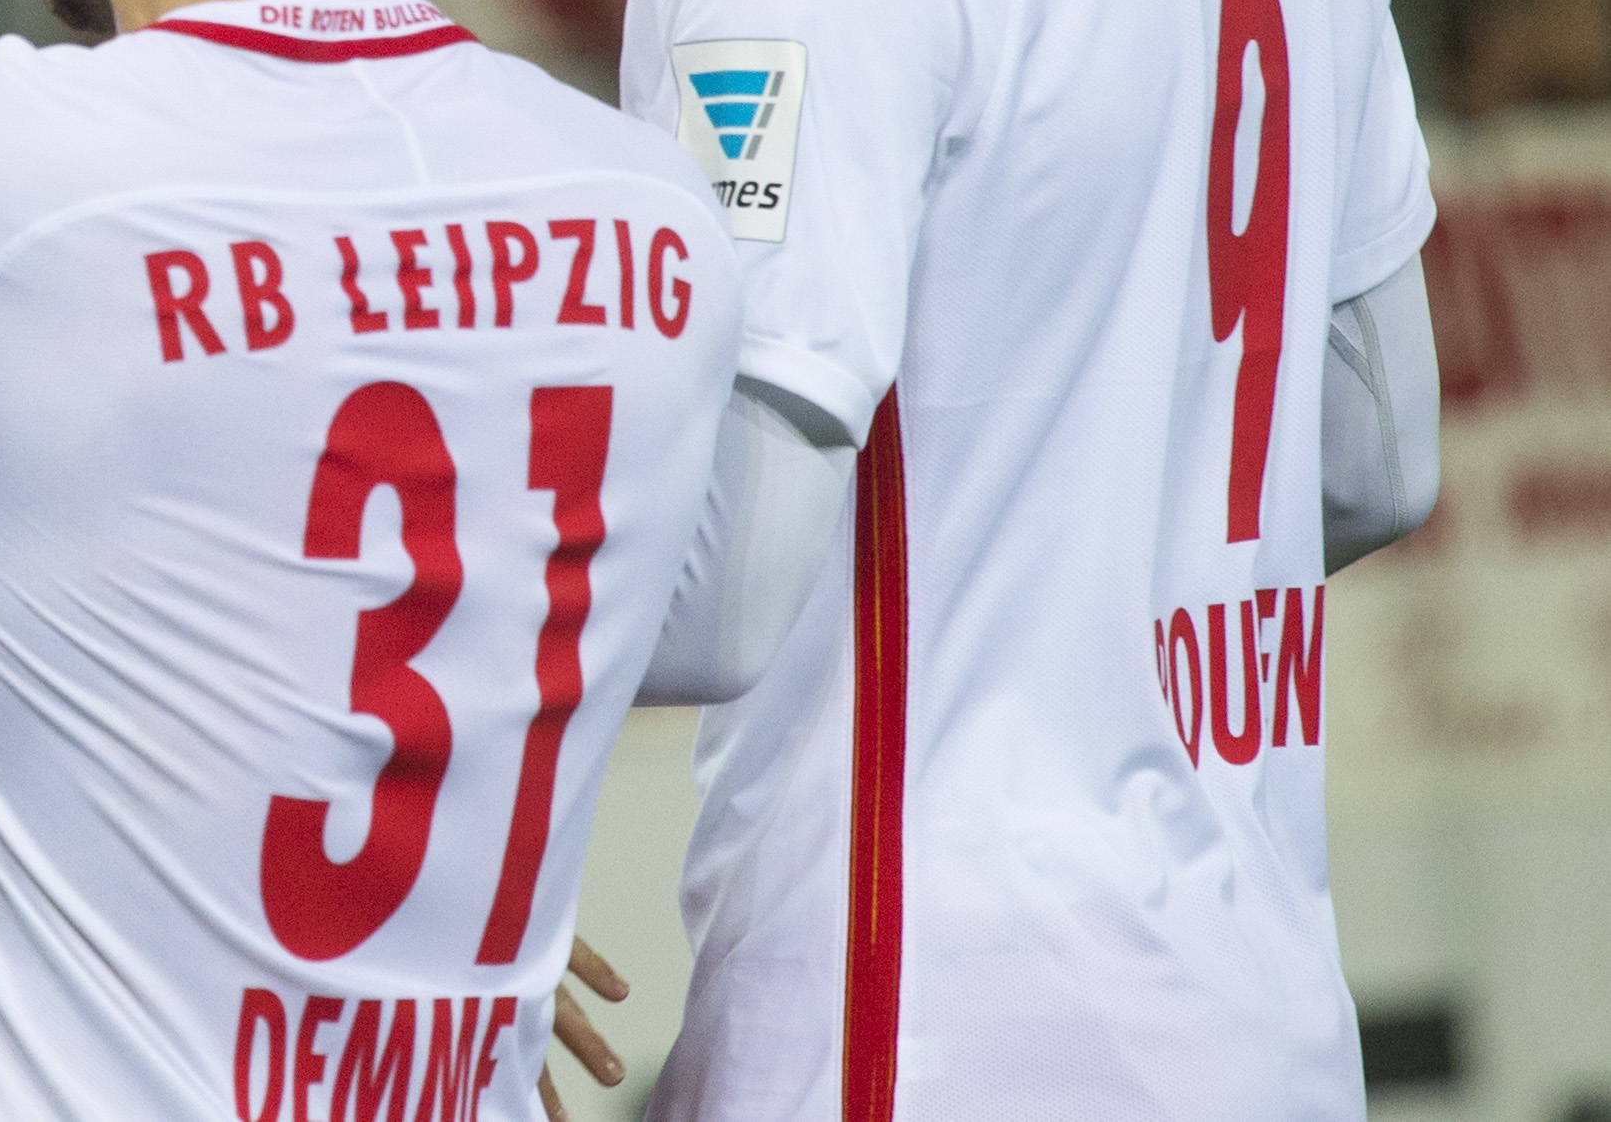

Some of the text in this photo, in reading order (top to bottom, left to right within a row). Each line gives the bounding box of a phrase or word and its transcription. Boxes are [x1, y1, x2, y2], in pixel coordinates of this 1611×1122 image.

[260, 5, 303, 29] DIE
[311, 8, 365, 32] ROTEN
[144, 218, 693, 363] RB LEIPZIG
[260, 380, 614, 966] 31
